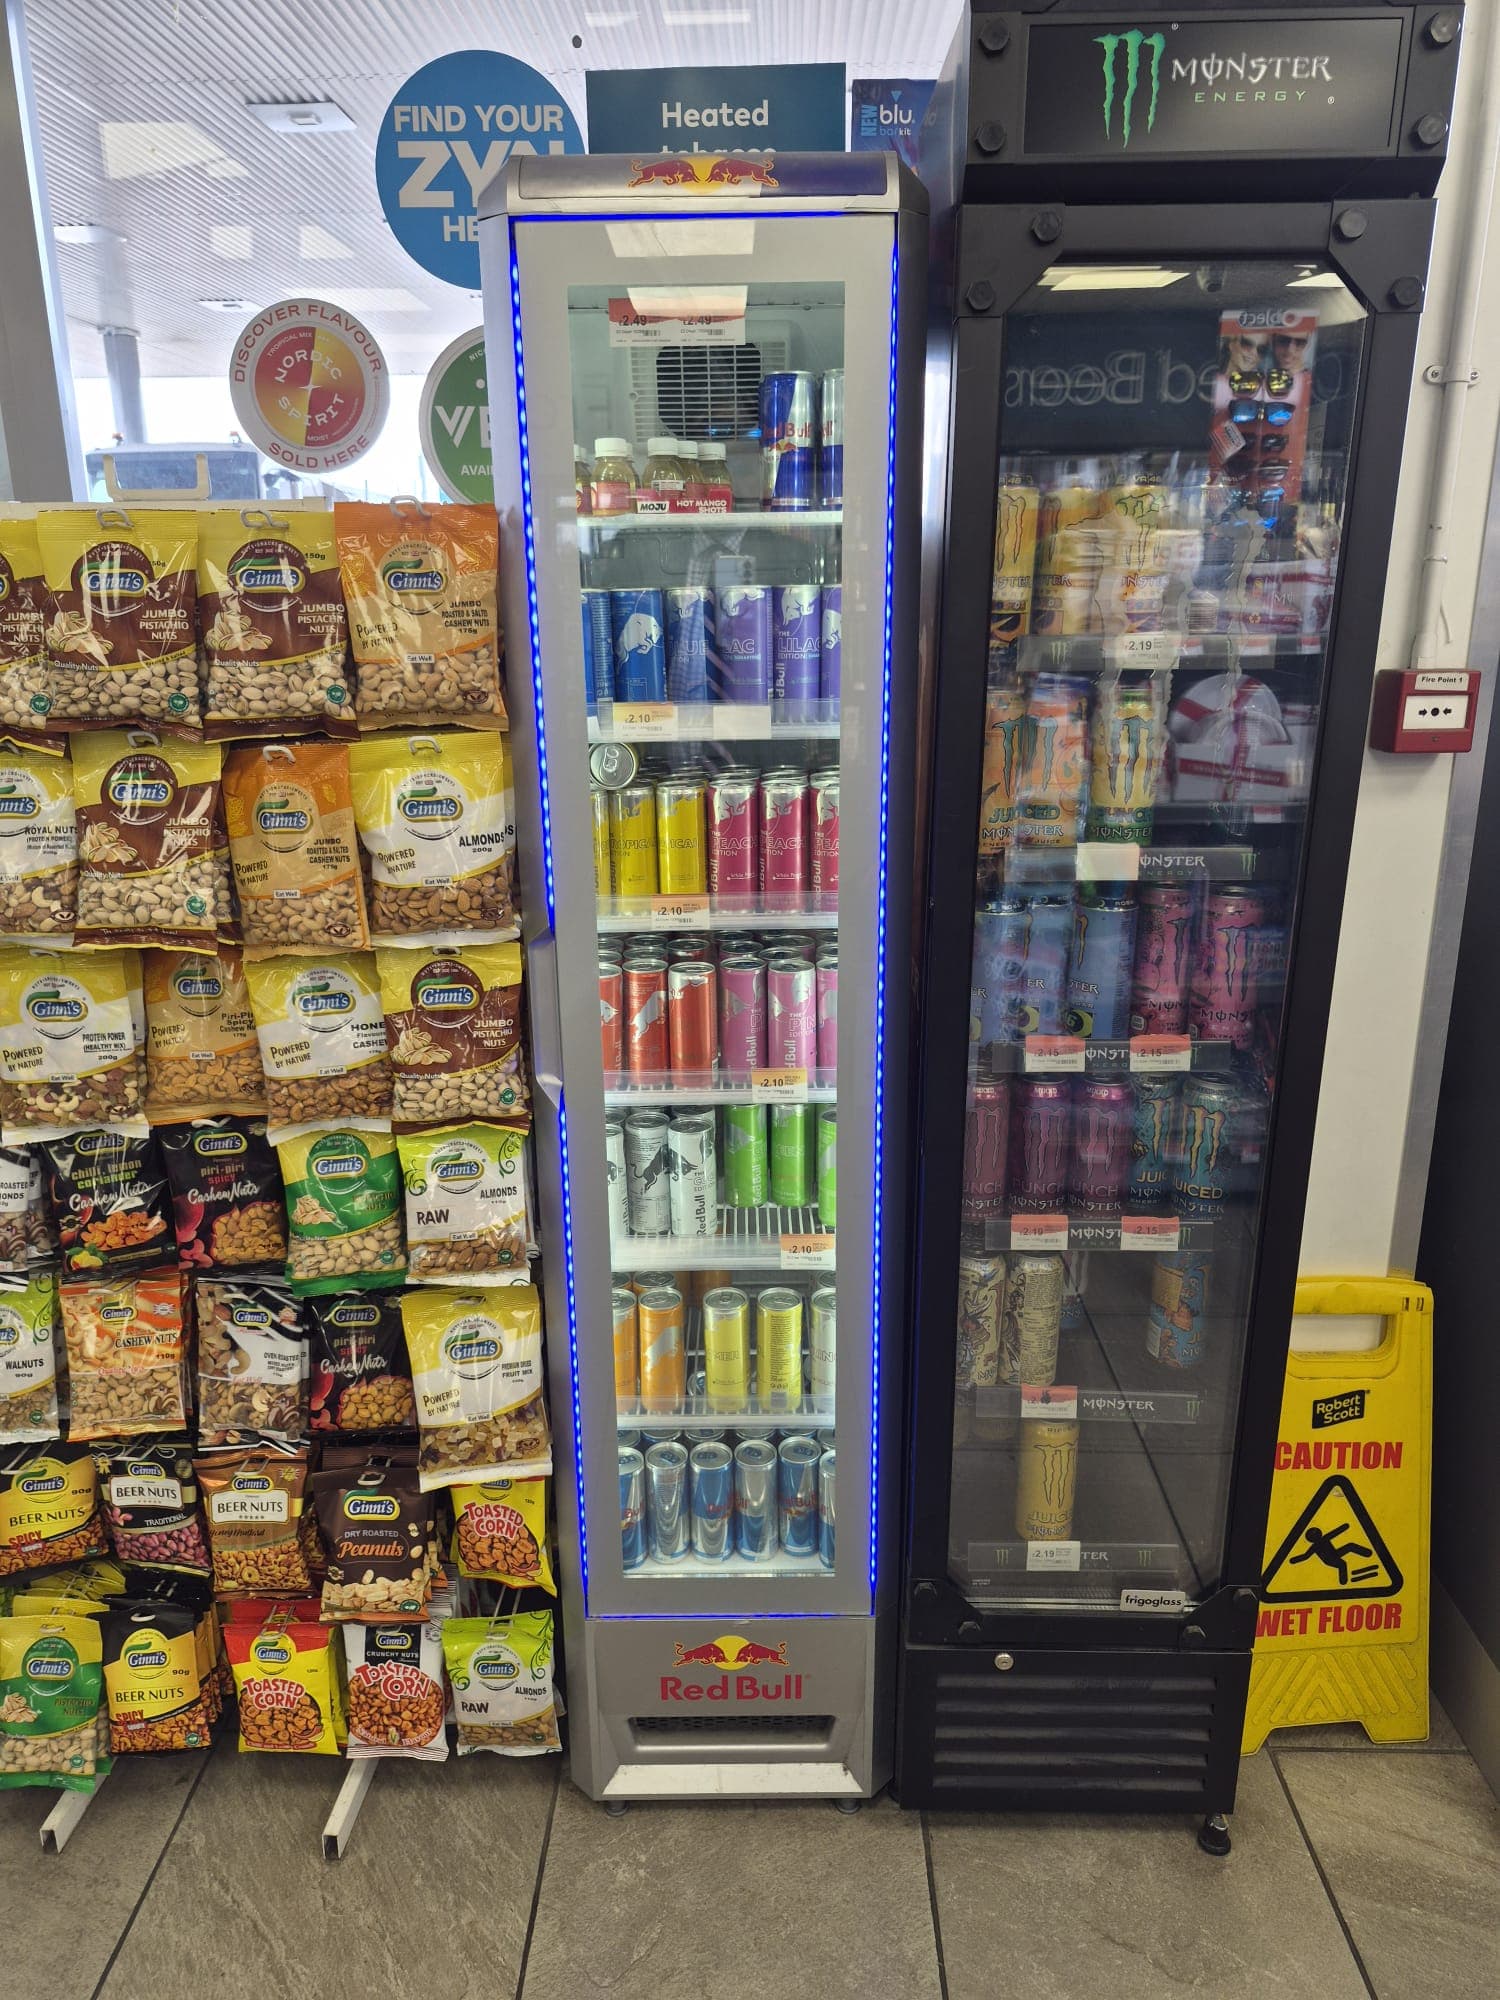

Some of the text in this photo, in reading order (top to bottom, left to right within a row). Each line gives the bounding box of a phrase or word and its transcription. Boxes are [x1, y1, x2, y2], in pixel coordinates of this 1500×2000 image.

[1195, 90, 1307, 104] ENERGY
[394, 104, 564, 132] FIND YOUR
[661, 99, 769, 128] Heated
[861, 104, 878, 137] NEW
[235, 304, 382, 383] DISCOVER FLAVOUR
[275, 349, 342, 383] NORDIC
[278, 393, 345, 426] SPIRIT
[269, 434, 369, 468] SOLD HERE
[640, 502, 667, 512] MOJU
[677, 499, 727, 508] HOT MANGO
[304, 552, 326, 565] 150g
[391, 570, 442, 590] Ginni's
[300, 603, 345, 614] JUMBO
[450, 600, 481, 611] JUMBO
[143, 608, 187, 620] JUMBO
[140, 619, 189, 634] PISTACHIO
[445, 618, 475, 632] CASHEW
[152, 632, 177, 644] NUTS
[55, 660, 79, 673] Quality
[1421, 676, 1436, 684] Fire
[1438, 676, 1457, 684] Point
[405, 800, 456, 817] Ginni's
[166, 817, 209, 828] JUMBO
[261, 811, 308, 830] Ginni's
[25, 824, 51, 838] ROYAL
[314, 837, 342, 846] JUMBO
[458, 830, 505, 848] ALMONDS
[309, 855, 334, 864] CASHEW
[1141, 853, 1205, 868] ONSTER
[235, 860, 269, 877] POWERED
[423, 988, 472, 1005] Ginni's
[34, 1001, 81, 1017] Ginni's
[351, 1020, 385, 1031] HONE
[474, 1018, 514, 1028] JUMBO
[483, 1037, 506, 1047] NUTS
[2, 1046, 44, 1062] POWERED
[270, 1040, 311, 1060] POWERED
[8, 1058, 44, 1073] BY NATURE
[275, 1052, 312, 1069] BY NATURE
[760, 1078, 784, 1087] £2.10
[200, 1138, 242, 1151] Ginni's
[317, 1158, 363, 1174] Ginni's
[437, 1163, 479, 1178] Ginni's
[187, 1179, 260, 1205] Cashew Nuts
[480, 1185, 518, 1200] ALMONDS
[69, 1190, 119, 1212] Cashew
[694, 1194, 706, 1216] Bull
[416, 1208, 450, 1226] RAW
[1070, 1226, 1122, 1241] MONST
[335, 1309, 376, 1322] Ginni's
[115, 1332, 178, 1349] CASHEW NUTS
[6, 1358, 45, 1370] WALNUTS
[1316, 1395, 1361, 1415] Robert
[1323, 1407, 1361, 1425] Scott
[1274, 1441, 1403, 1471] CAUTION
[23, 1479, 63, 1492] Ginni's
[116, 1486, 178, 1500] BEER NUTS
[217, 1501, 284, 1514] BEER NUTS
[349, 1500, 395, 1516] Ginni's
[464, 1502, 524, 1527] TOASTED
[9, 1506, 86, 1528] BEER NUTS
[144, 1512, 187, 1527] TRADITIONAL
[344, 1529, 400, 1539] DRY ROASTED
[475, 1519, 517, 1539] CORN
[336, 1540, 405, 1559] Peanuts
[1125, 1595, 1182, 1607] frigoglass
[1256, 1603, 1403, 1638] WET FLOOR
[129, 1651, 166, 1667] Ginni's
[366, 1650, 399, 1659] CRUNCHY
[30, 1660, 71, 1675] Ginni's
[172, 1668, 190, 1676] 90g
[115, 1686, 185, 1703] BEER NUTS
[242, 1678, 305, 1697] TOASTED
[383, 1674, 431, 1700] CORN
[514, 1684, 547, 1697] ALMONDS
[660, 1674, 802, 1701] Red Bull
[260, 1693, 298, 1709] CORN
[461, 1700, 489, 1714] RAW
